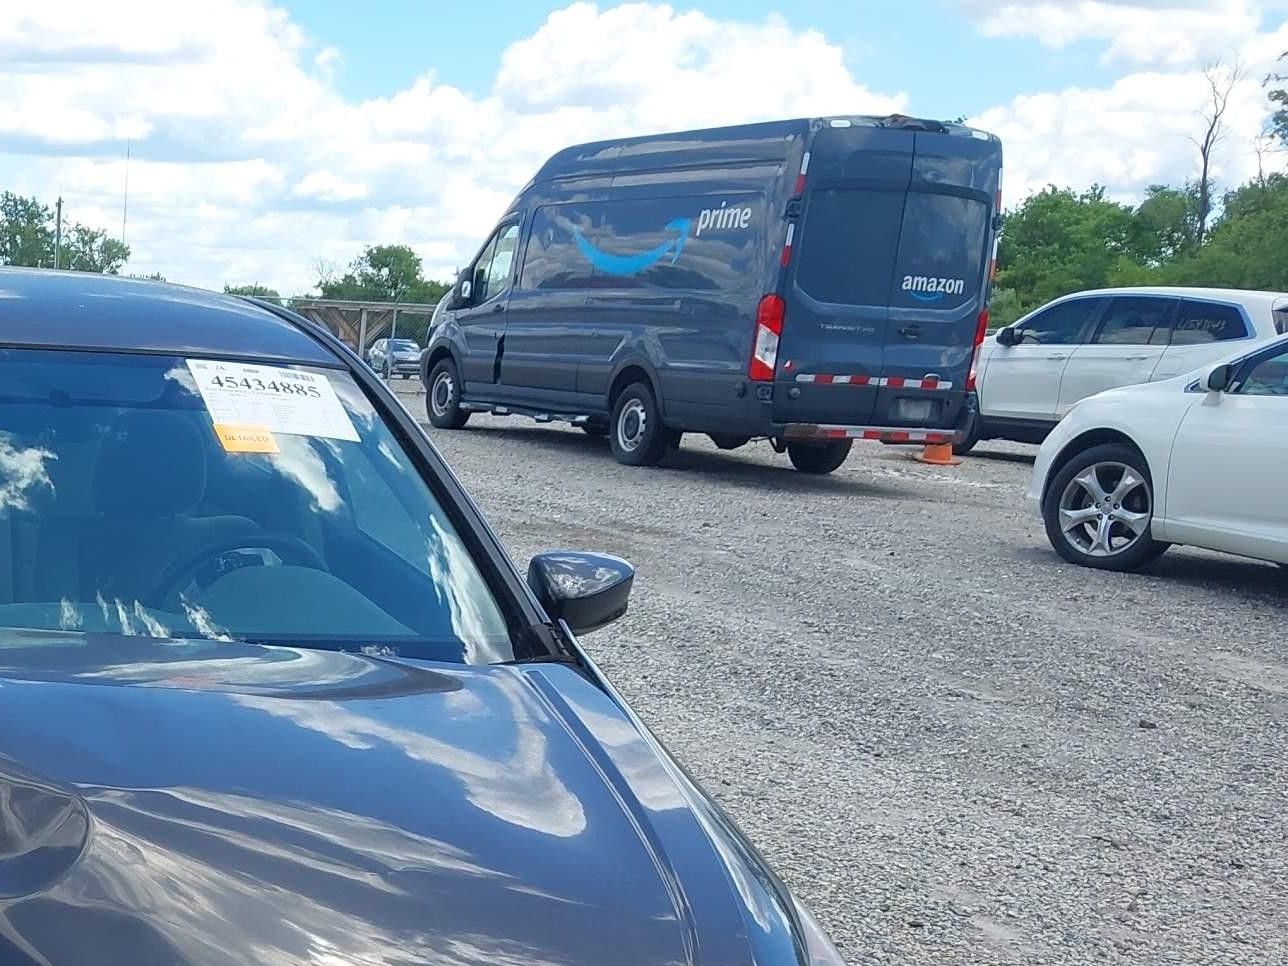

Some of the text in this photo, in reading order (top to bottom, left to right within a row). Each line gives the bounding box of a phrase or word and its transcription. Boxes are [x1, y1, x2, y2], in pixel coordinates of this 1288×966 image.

[695, 200, 752, 237] prime
[901, 275, 964, 295] amazon
[211, 375, 321, 398] 45434885
